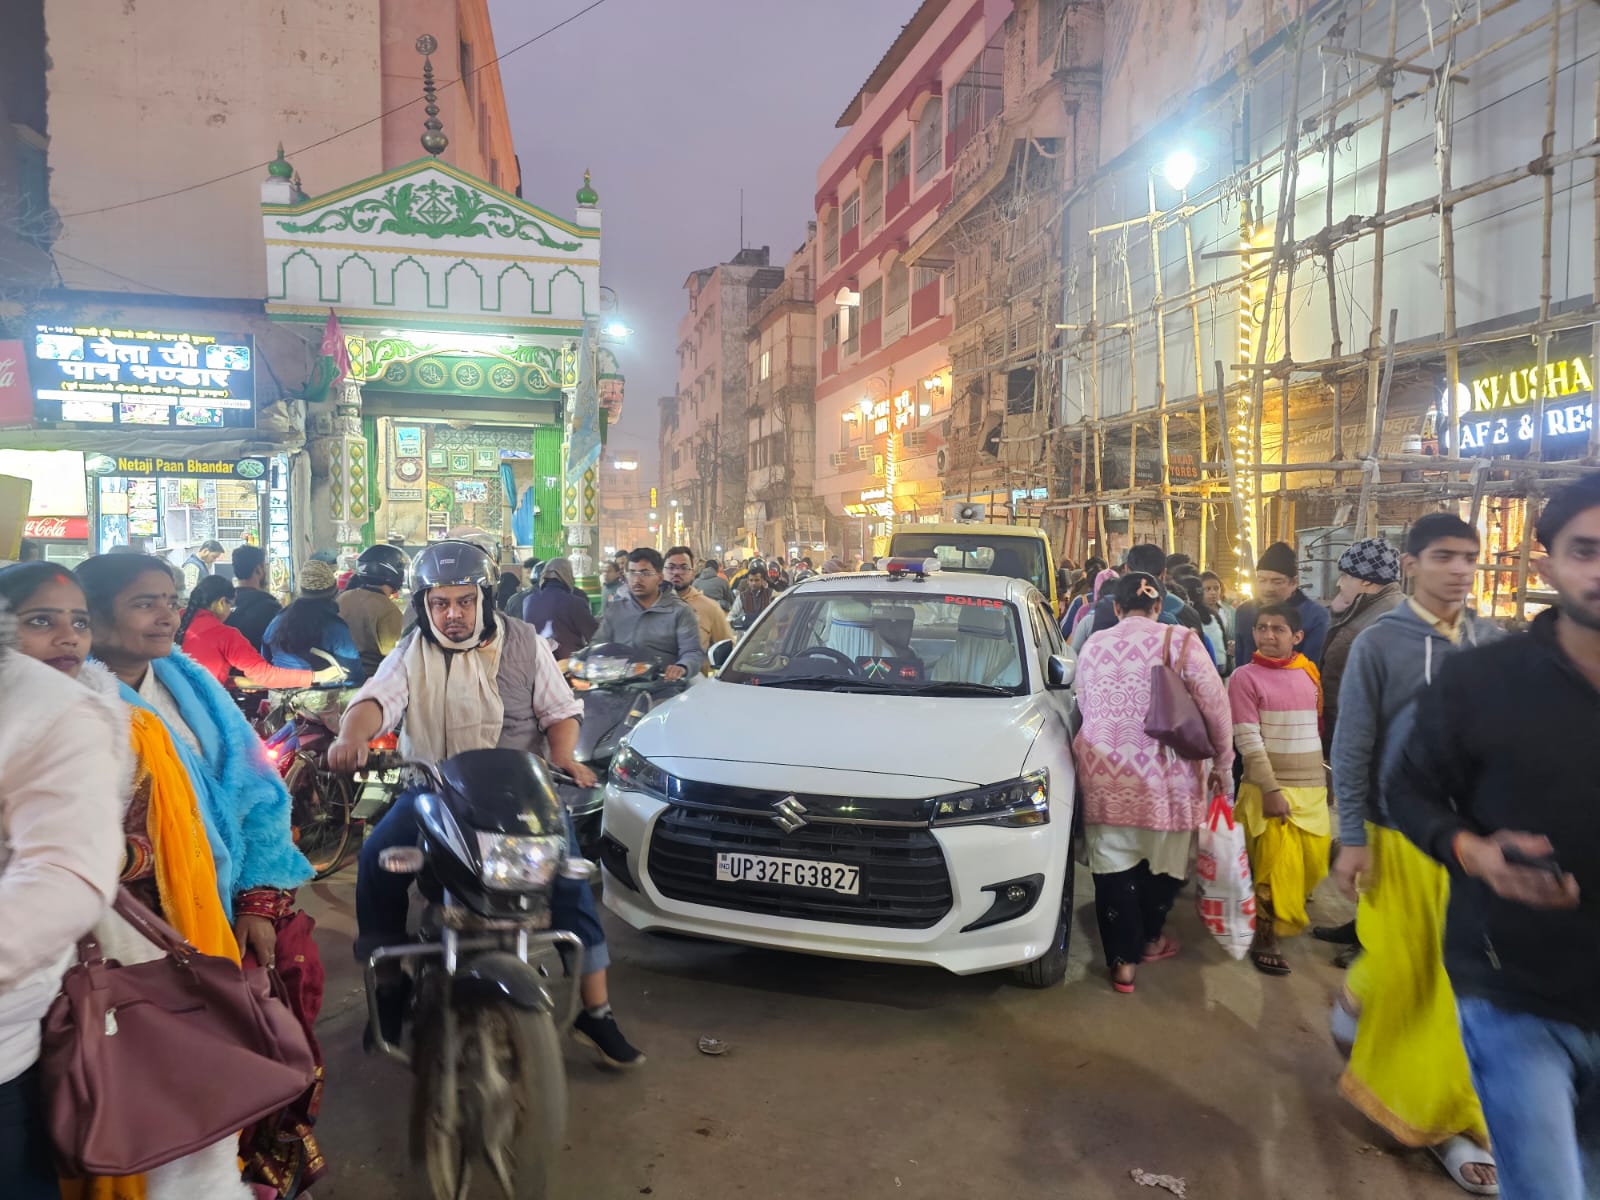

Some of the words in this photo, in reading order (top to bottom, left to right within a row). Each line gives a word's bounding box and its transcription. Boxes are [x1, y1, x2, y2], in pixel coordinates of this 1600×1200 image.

[90, 337, 151, 364] नेता
[158, 341, 199, 368] जी
[58, 361, 121, 382] पान
[129, 364, 230, 388] भण्डार
[1445, 418, 1509, 449] AFE
[118, 457, 153, 474] Netaji
[156, 459, 184, 472] Paan
[187, 460, 234, 474] Bhandar
[1169, 466, 1198, 478] TORES
[944, 595, 1004, 610] POLICE
[730, 857, 859, 891] UP32FG3827
